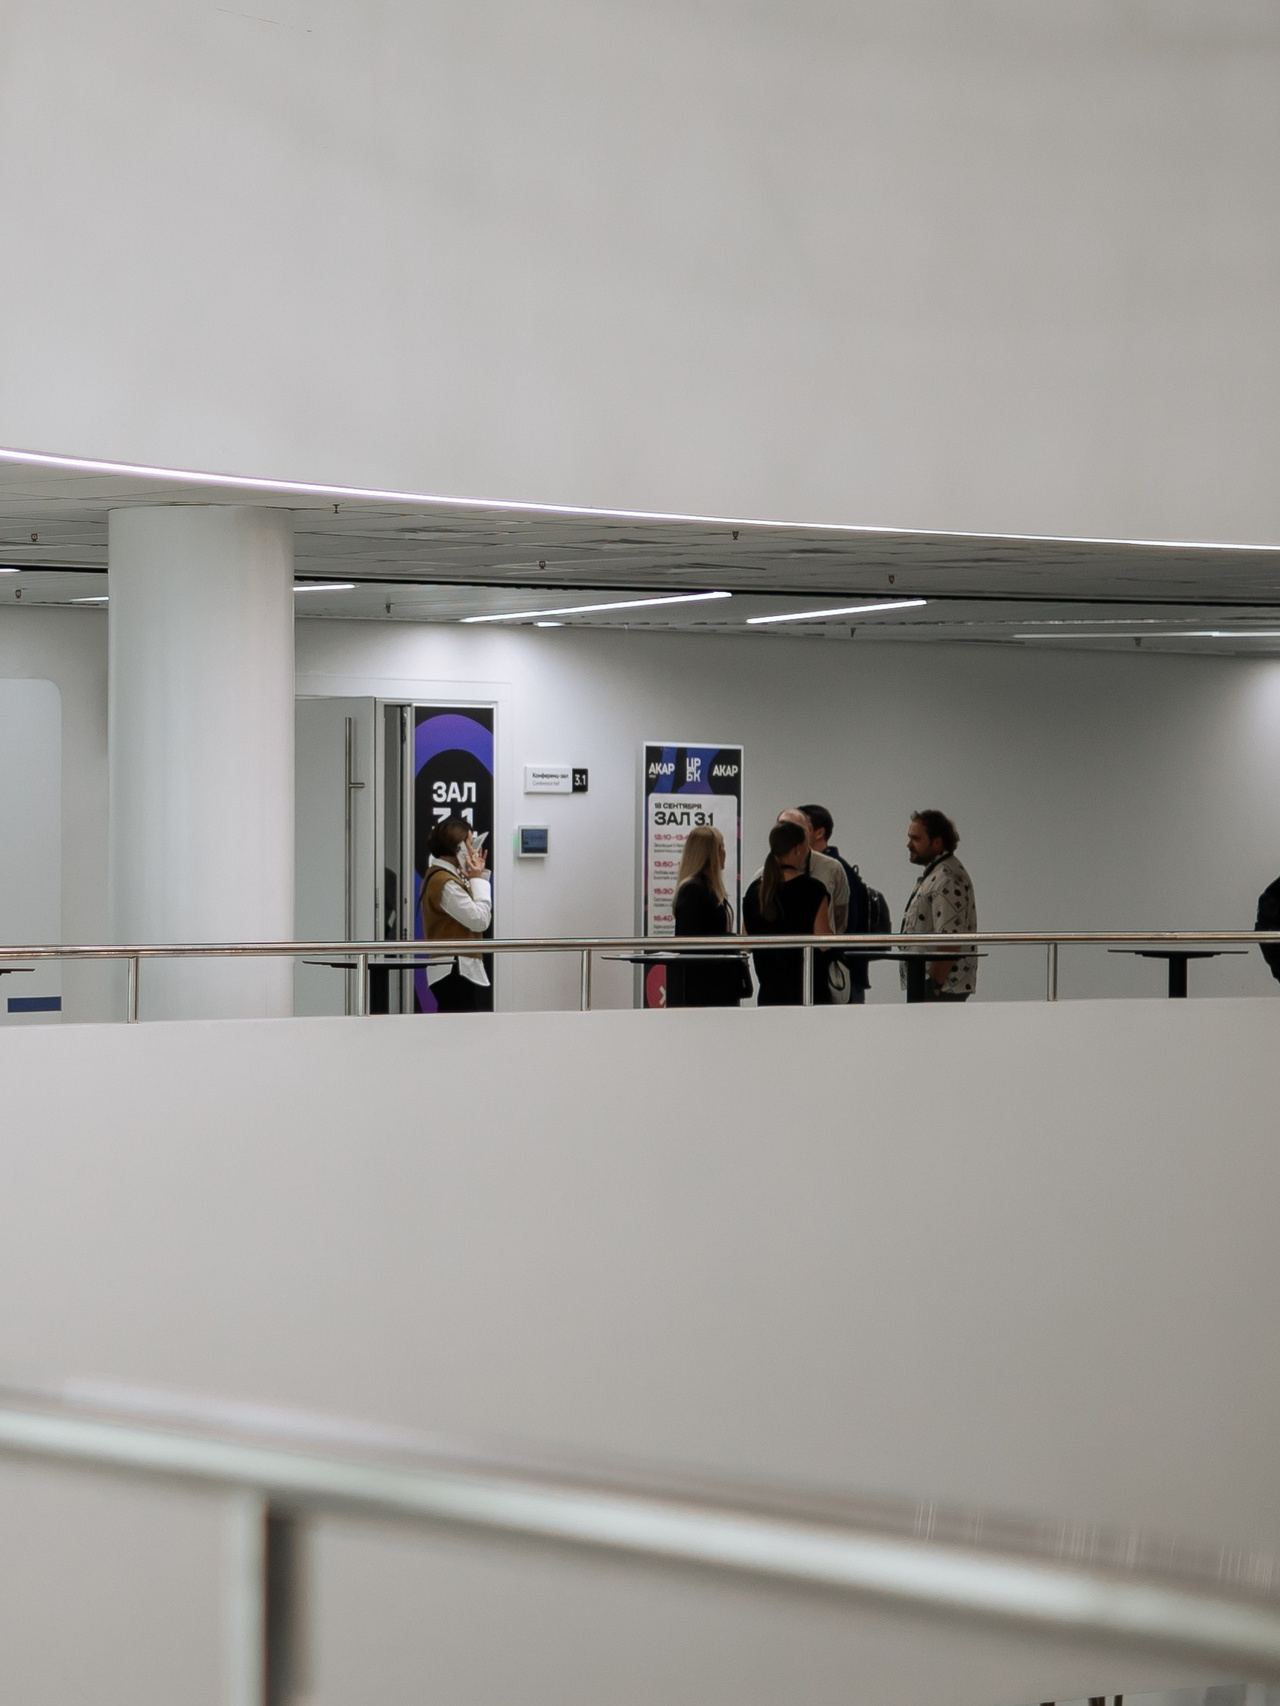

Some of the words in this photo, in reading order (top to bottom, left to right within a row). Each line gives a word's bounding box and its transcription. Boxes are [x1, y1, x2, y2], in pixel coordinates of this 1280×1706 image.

[648, 762, 676, 775] АКАР
[712, 764, 739, 777] АКАР
[574, 773, 587, 786] 3.1
[432, 781, 477, 803] ЗАЛ
[654, 811, 690, 826] ЗАЛ
[694, 812, 714, 827] 3.1
